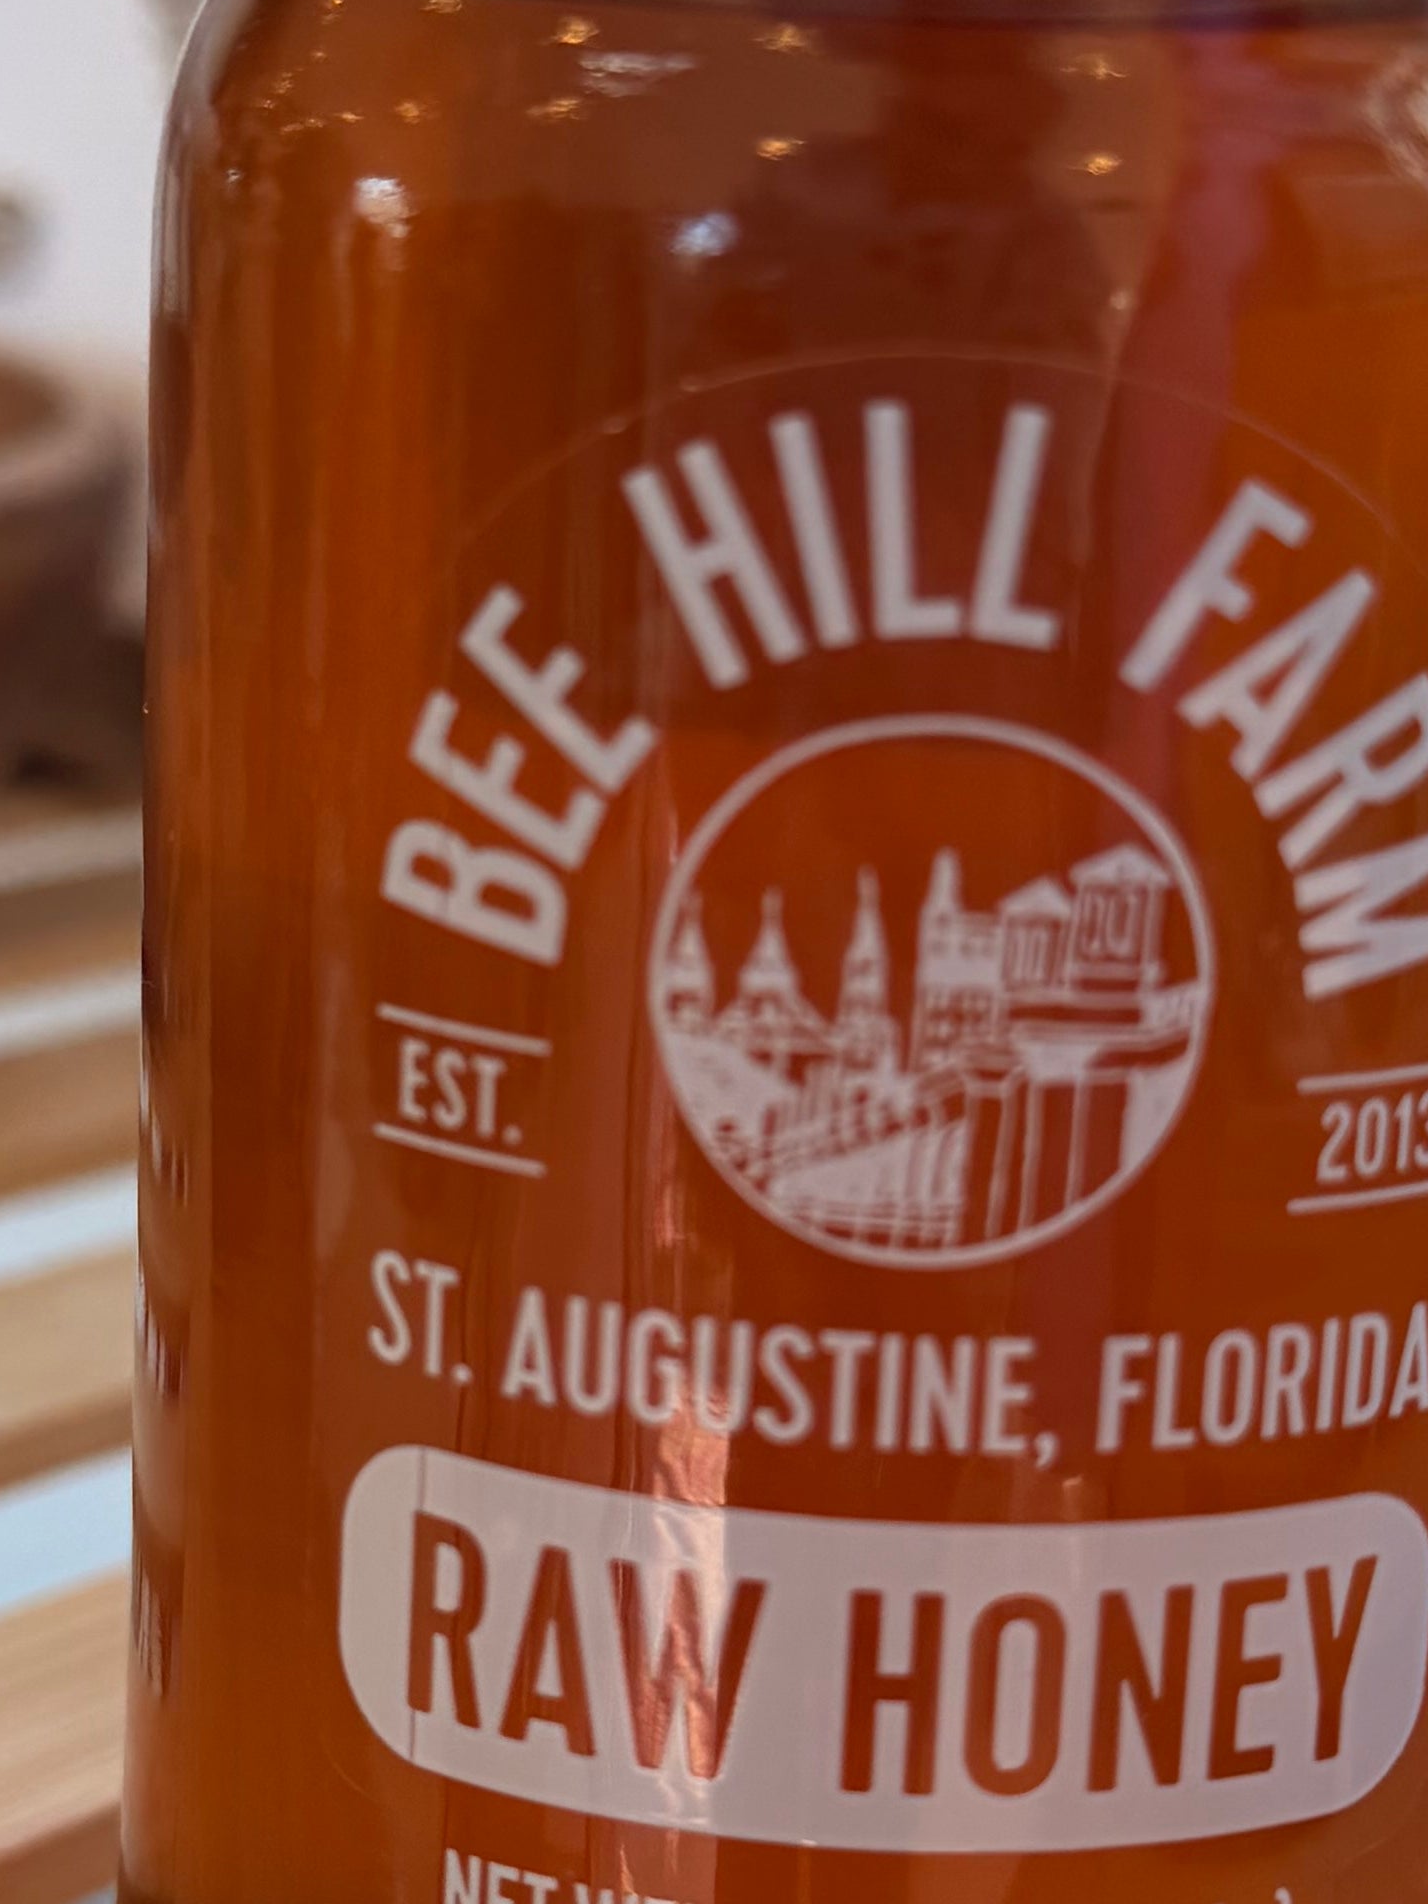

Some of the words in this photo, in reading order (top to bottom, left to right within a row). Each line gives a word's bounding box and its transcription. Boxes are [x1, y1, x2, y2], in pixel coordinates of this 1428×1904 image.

[381, 584, 656, 966] BEE
[624, 399, 1060, 688] HILL
[399, 1047, 520, 1145] EST.
[368, 1252, 470, 1382] ST.
[503, 1290, 1058, 1467] AUGUSTINE,
[404, 1511, 768, 1781] RAW
[840, 1556, 1380, 1798] HONEY
